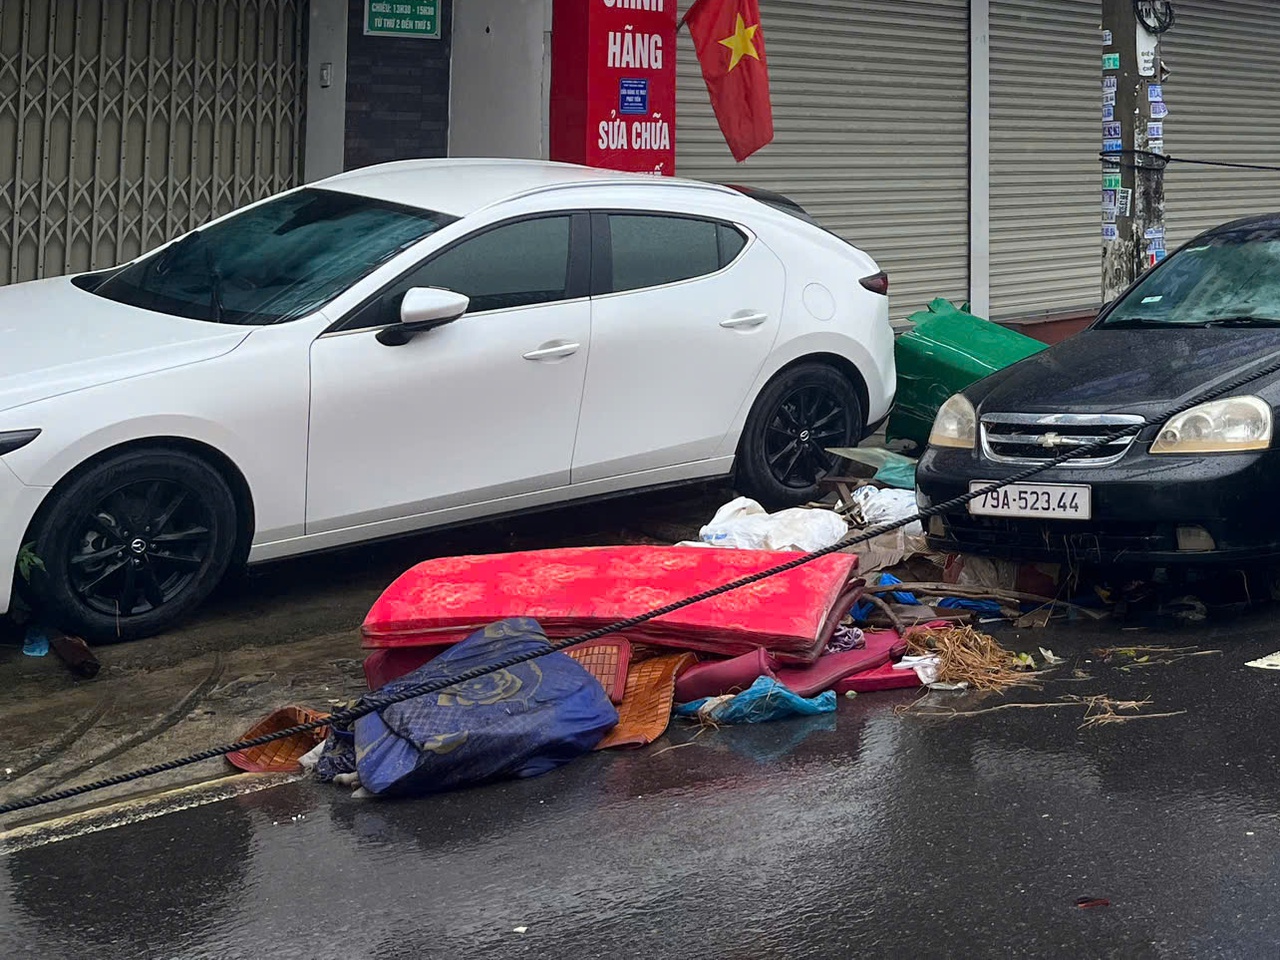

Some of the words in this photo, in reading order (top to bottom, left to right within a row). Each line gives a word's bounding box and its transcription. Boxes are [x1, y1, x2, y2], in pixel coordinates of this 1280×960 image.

[607, 24, 663, 70] HÃNG
[598, 109, 628, 150] SỬA
[631, 112, 670, 150] CHỮA
[981, 488, 1079, 513] 79A-523.44
